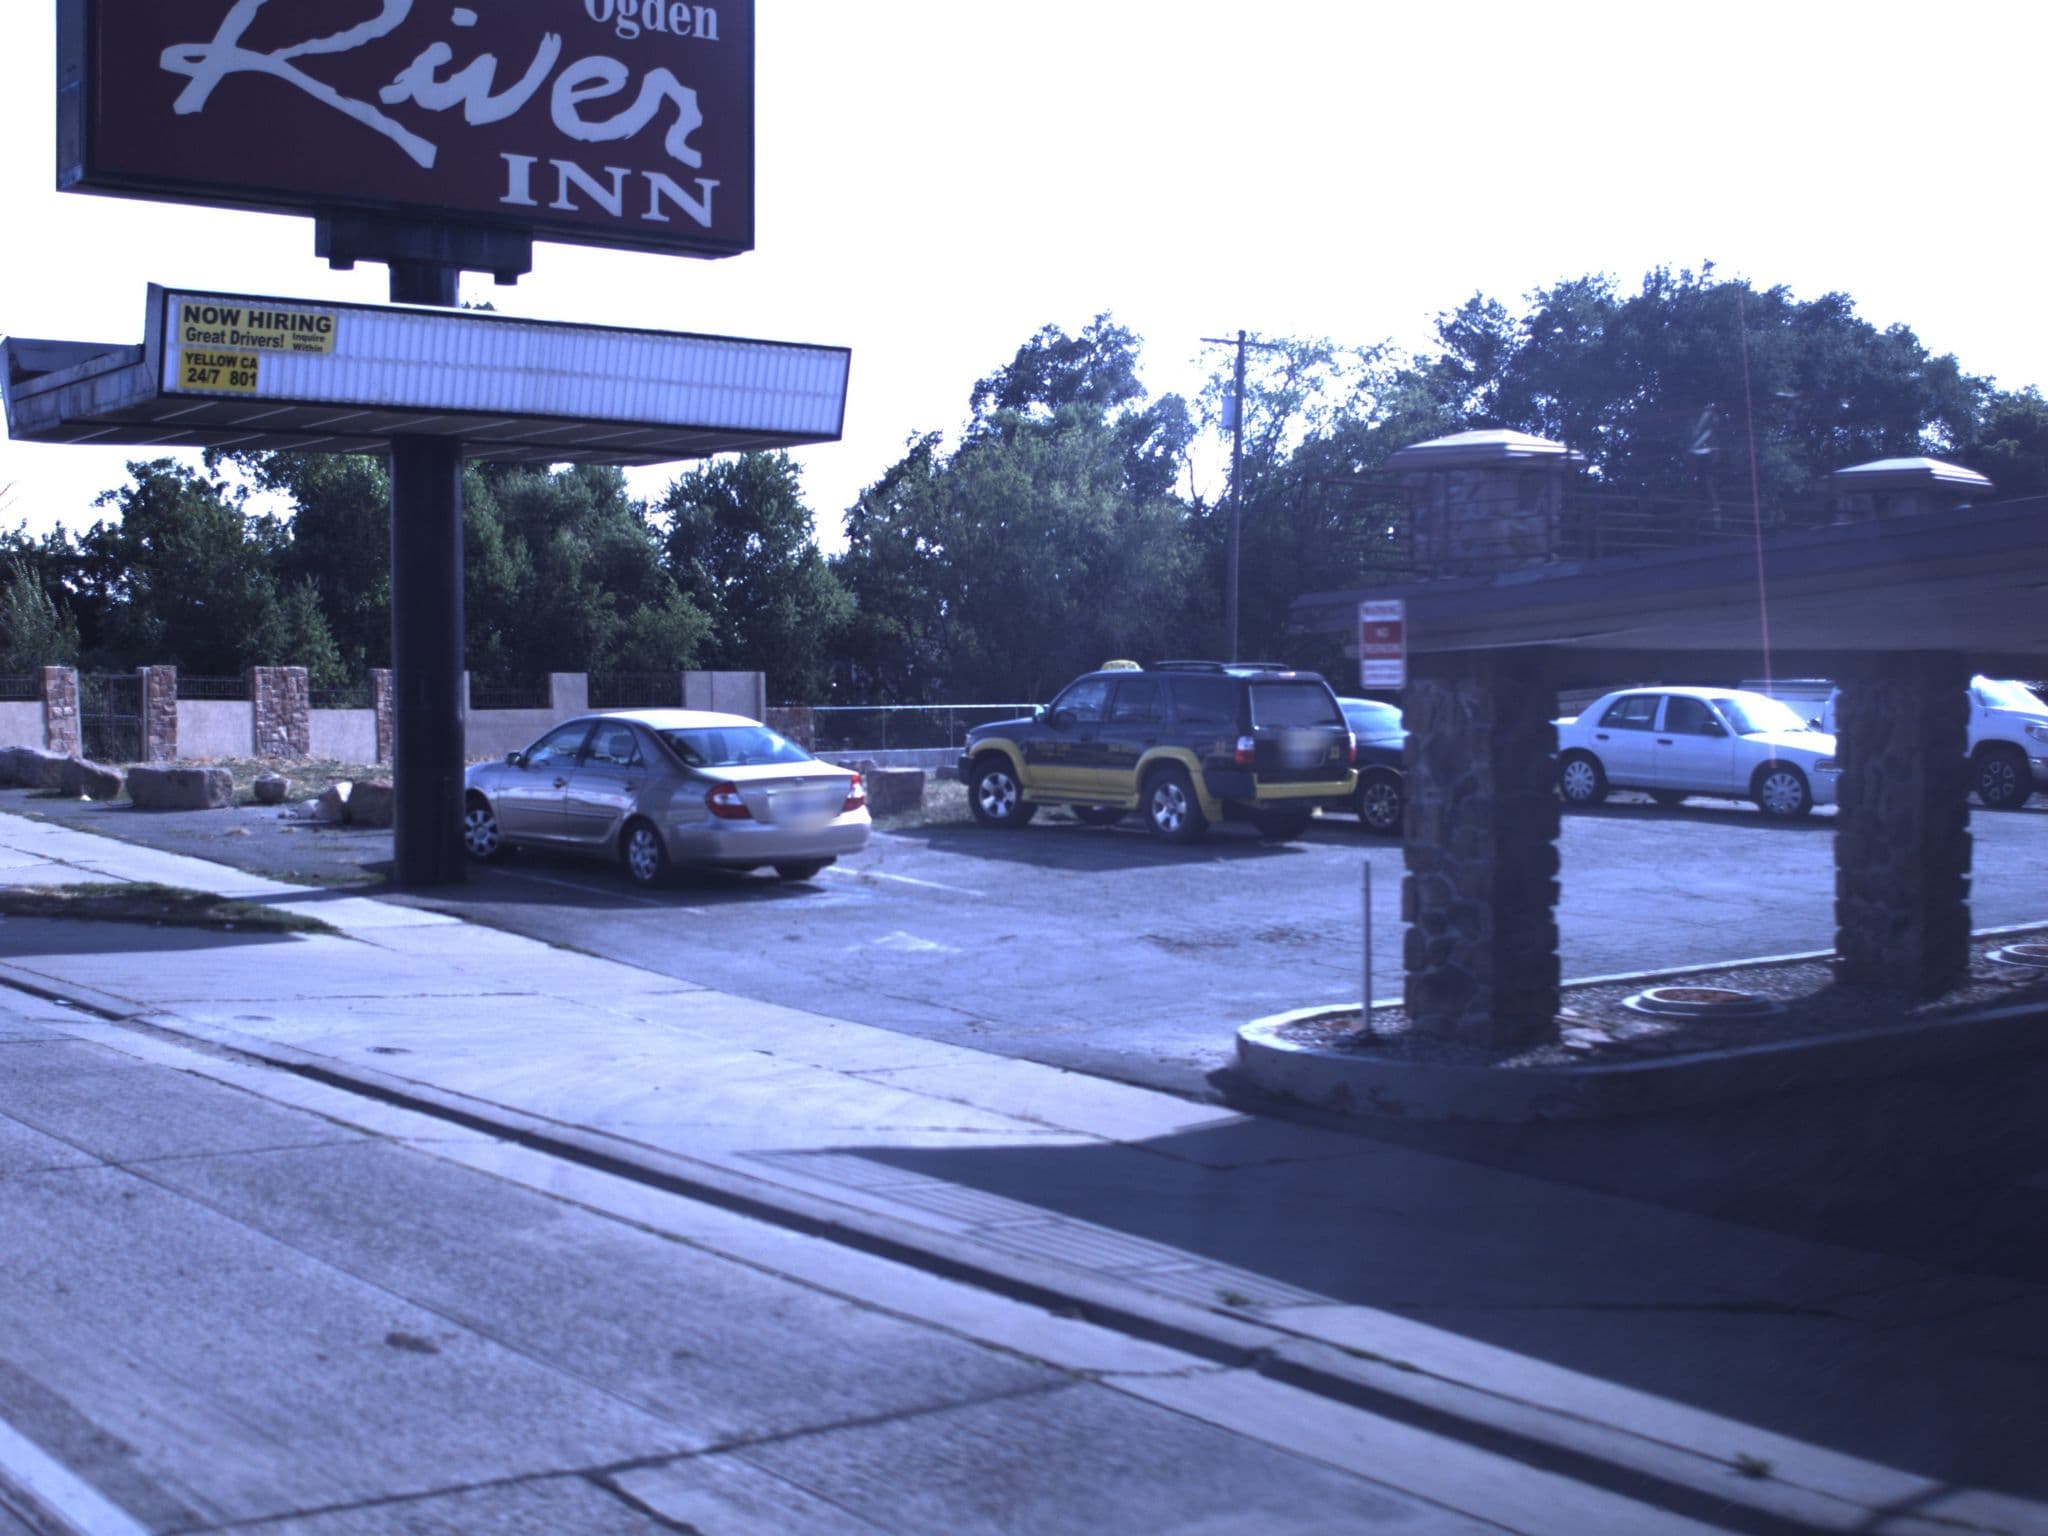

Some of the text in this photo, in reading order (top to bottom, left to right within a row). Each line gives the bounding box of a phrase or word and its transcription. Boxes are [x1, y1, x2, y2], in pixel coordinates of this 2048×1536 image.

[160, 0, 703, 169] River
[500, 153, 720, 228] INN
[183, 304, 332, 334] NOW HIRING
[185, 326, 285, 349] Great Drivers!
[185, 351, 237, 368] YELLOW
[187, 367, 257, 387] 24/7 801
